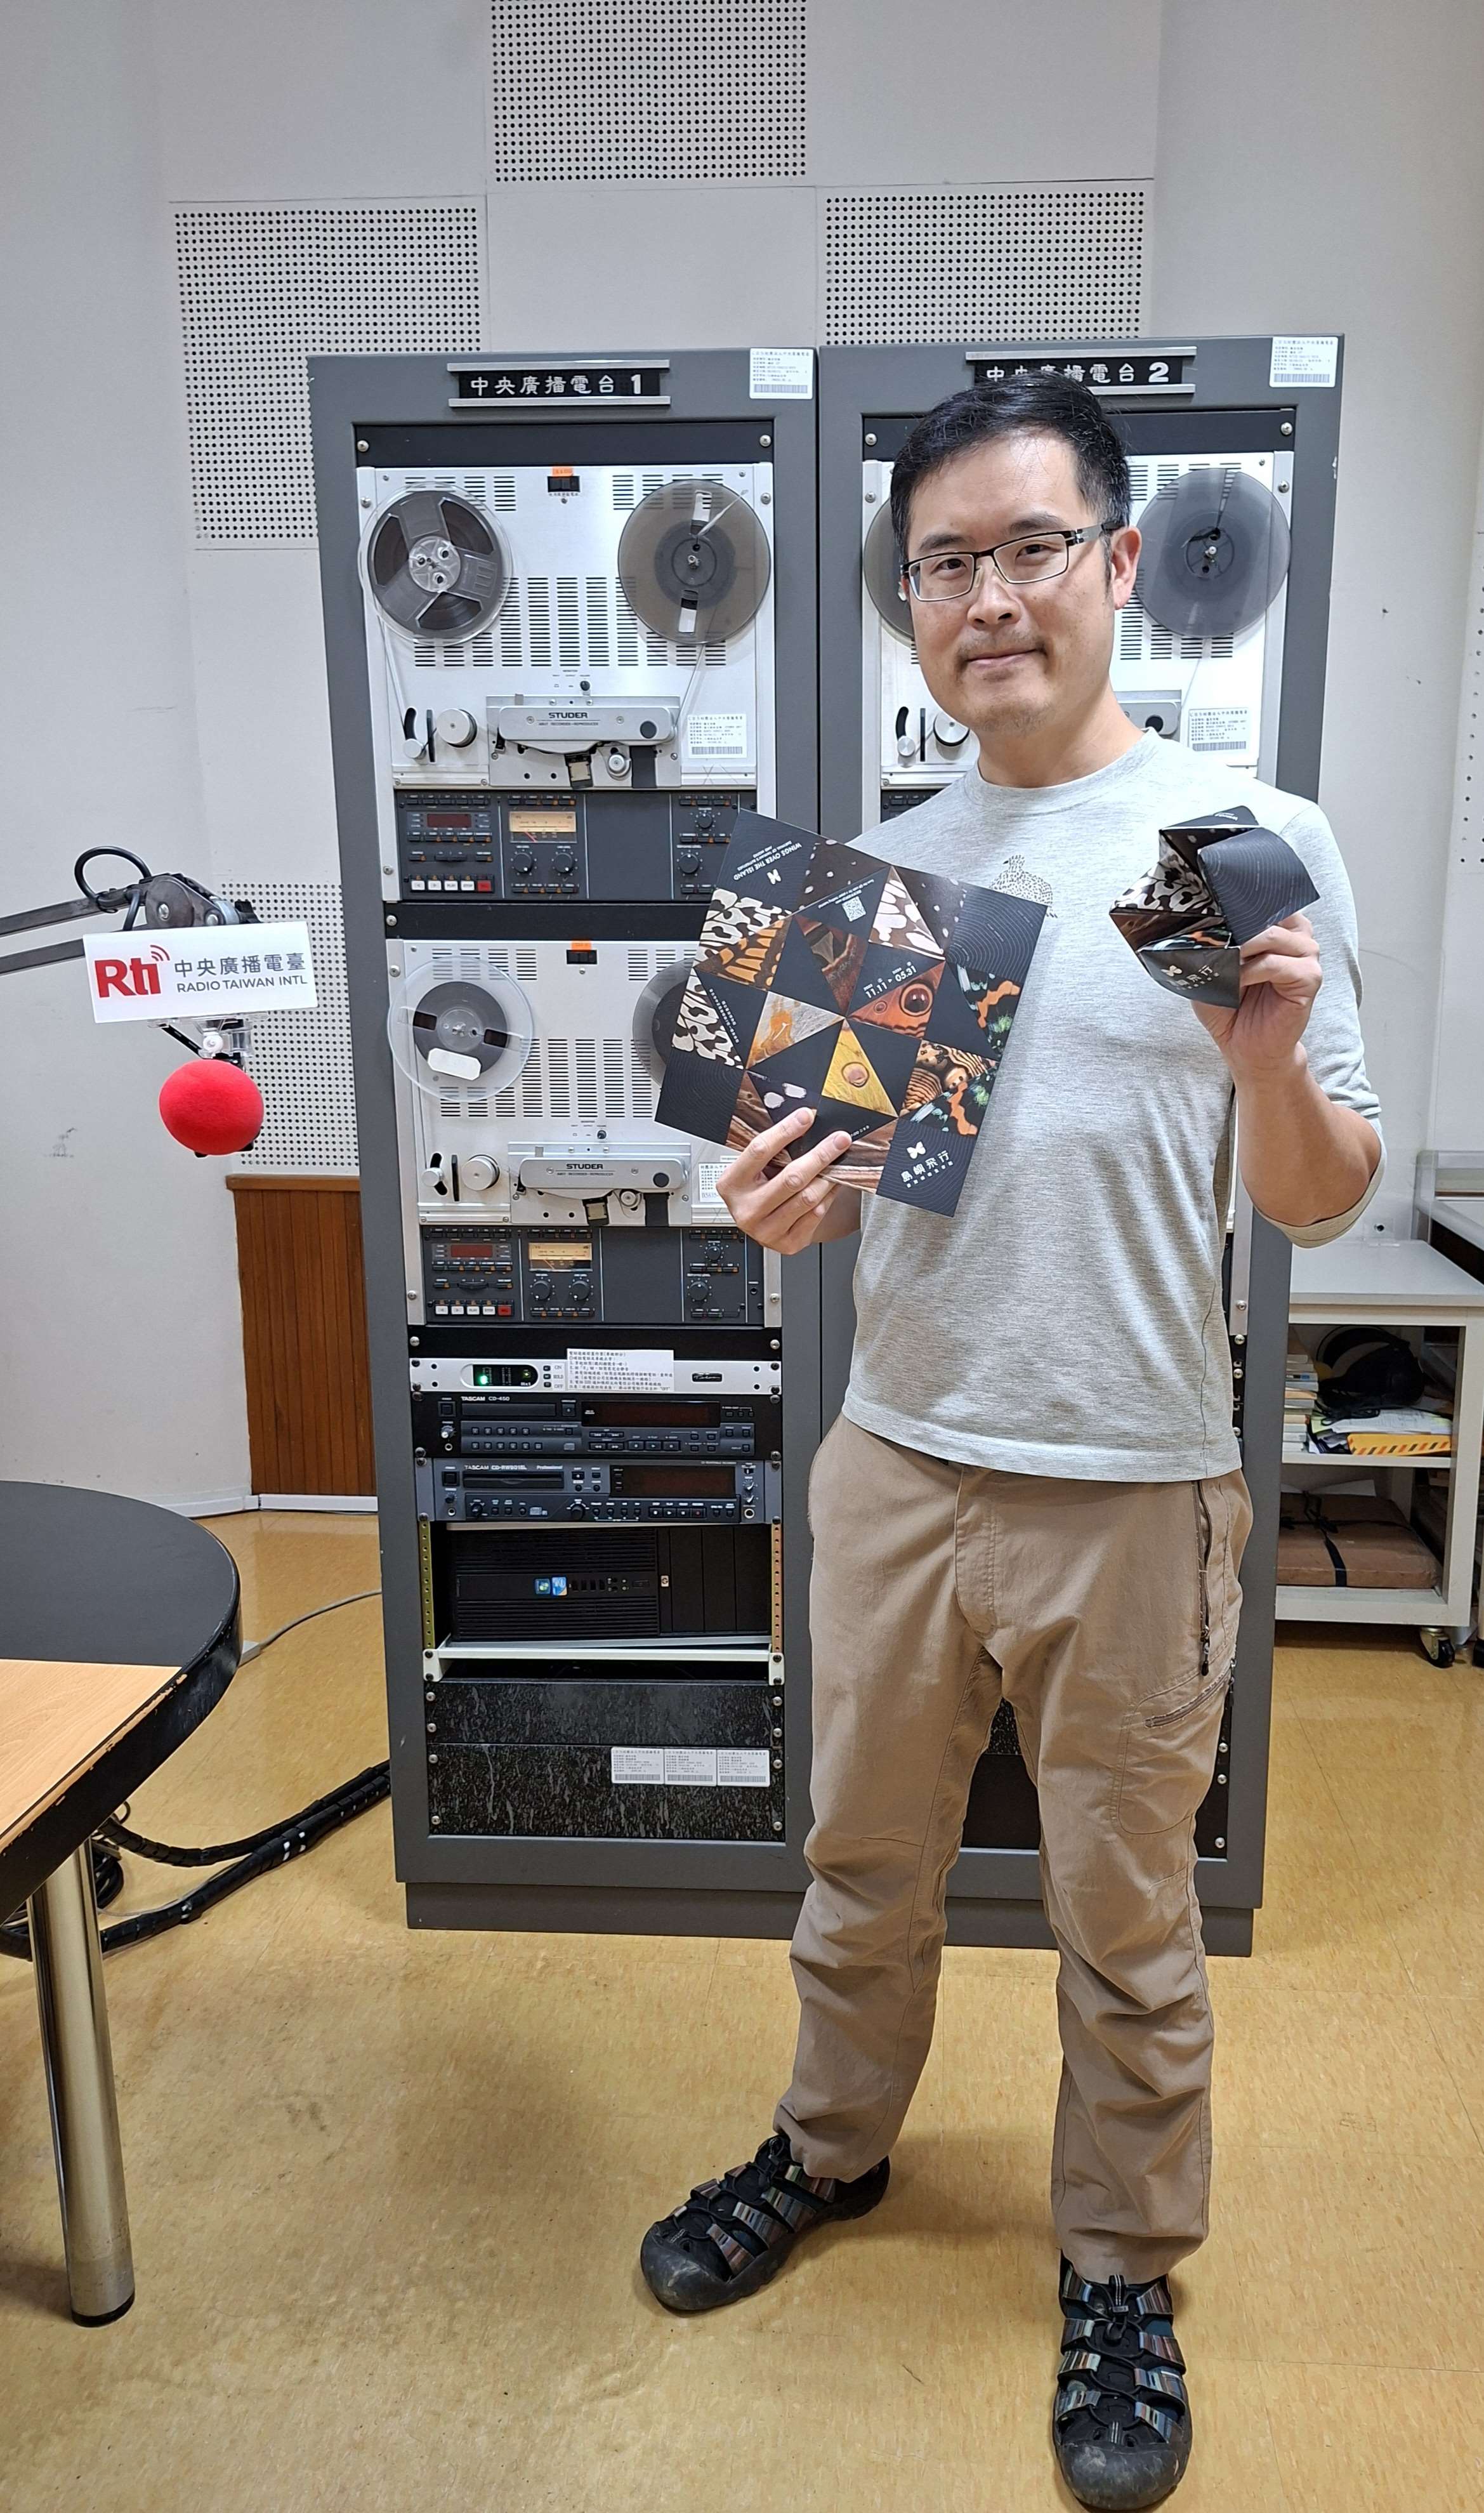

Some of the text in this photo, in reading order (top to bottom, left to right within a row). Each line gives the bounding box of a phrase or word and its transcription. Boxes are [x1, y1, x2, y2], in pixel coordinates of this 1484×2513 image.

[1148, 362, 1169, 383] 2
[471, 374, 641, 396] 中央廣播電台 1
[733, 843, 802, 880] WINGS OVER THE ISLAND
[174, 953, 306, 977] 中央廣播電臺
[178, 975, 308, 993] RADIO TAIWAN INTL
[865, 965, 917, 998] 11.11 05.31
